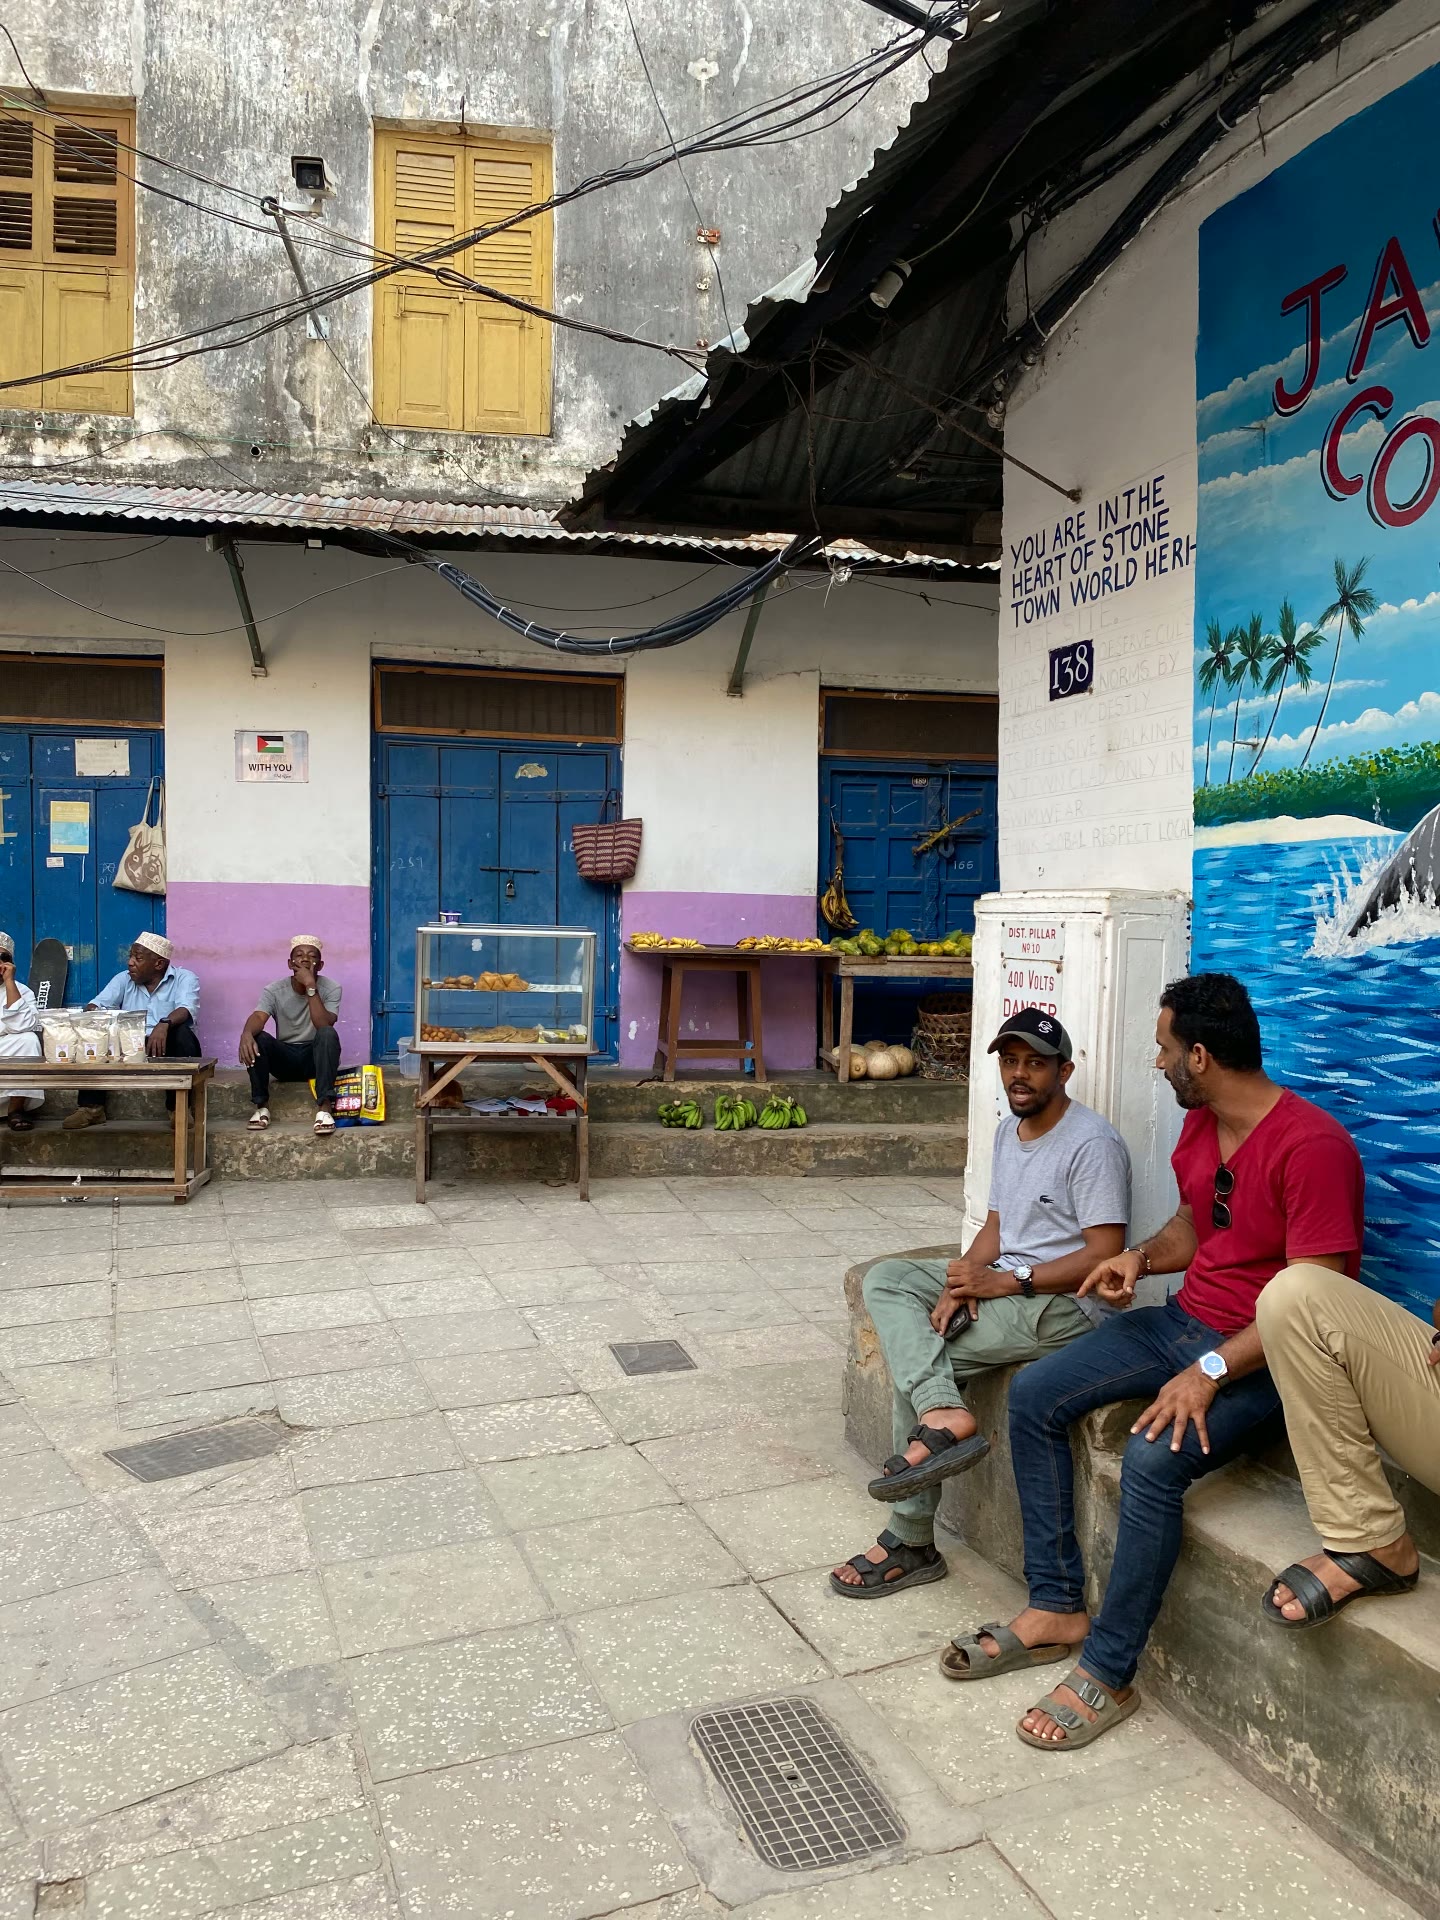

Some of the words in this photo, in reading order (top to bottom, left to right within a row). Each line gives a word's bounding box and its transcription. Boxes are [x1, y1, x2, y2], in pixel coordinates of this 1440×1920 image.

[1272, 207, 1440, 417] JA
[1011, 529, 1046, 569] YOU
[1053, 510, 1086, 549] ARE
[1012, 552, 1067, 598] HEART
[1070, 539, 1096, 574] OF
[1102, 508, 1170, 562] STONE
[1011, 586, 1061, 628] TOWN
[1070, 557, 1138, 607] WORLD
[1052, 644, 1089, 694] 138
[248, 763, 272, 772] WITH
[273, 763, 292, 772] YOU
[1092, 822, 1152, 848] RESPECT
[1009, 927, 1027, 938] DIST.
[1030, 928, 1056, 939] PILLAR
[1008, 970, 1024, 988] 400
